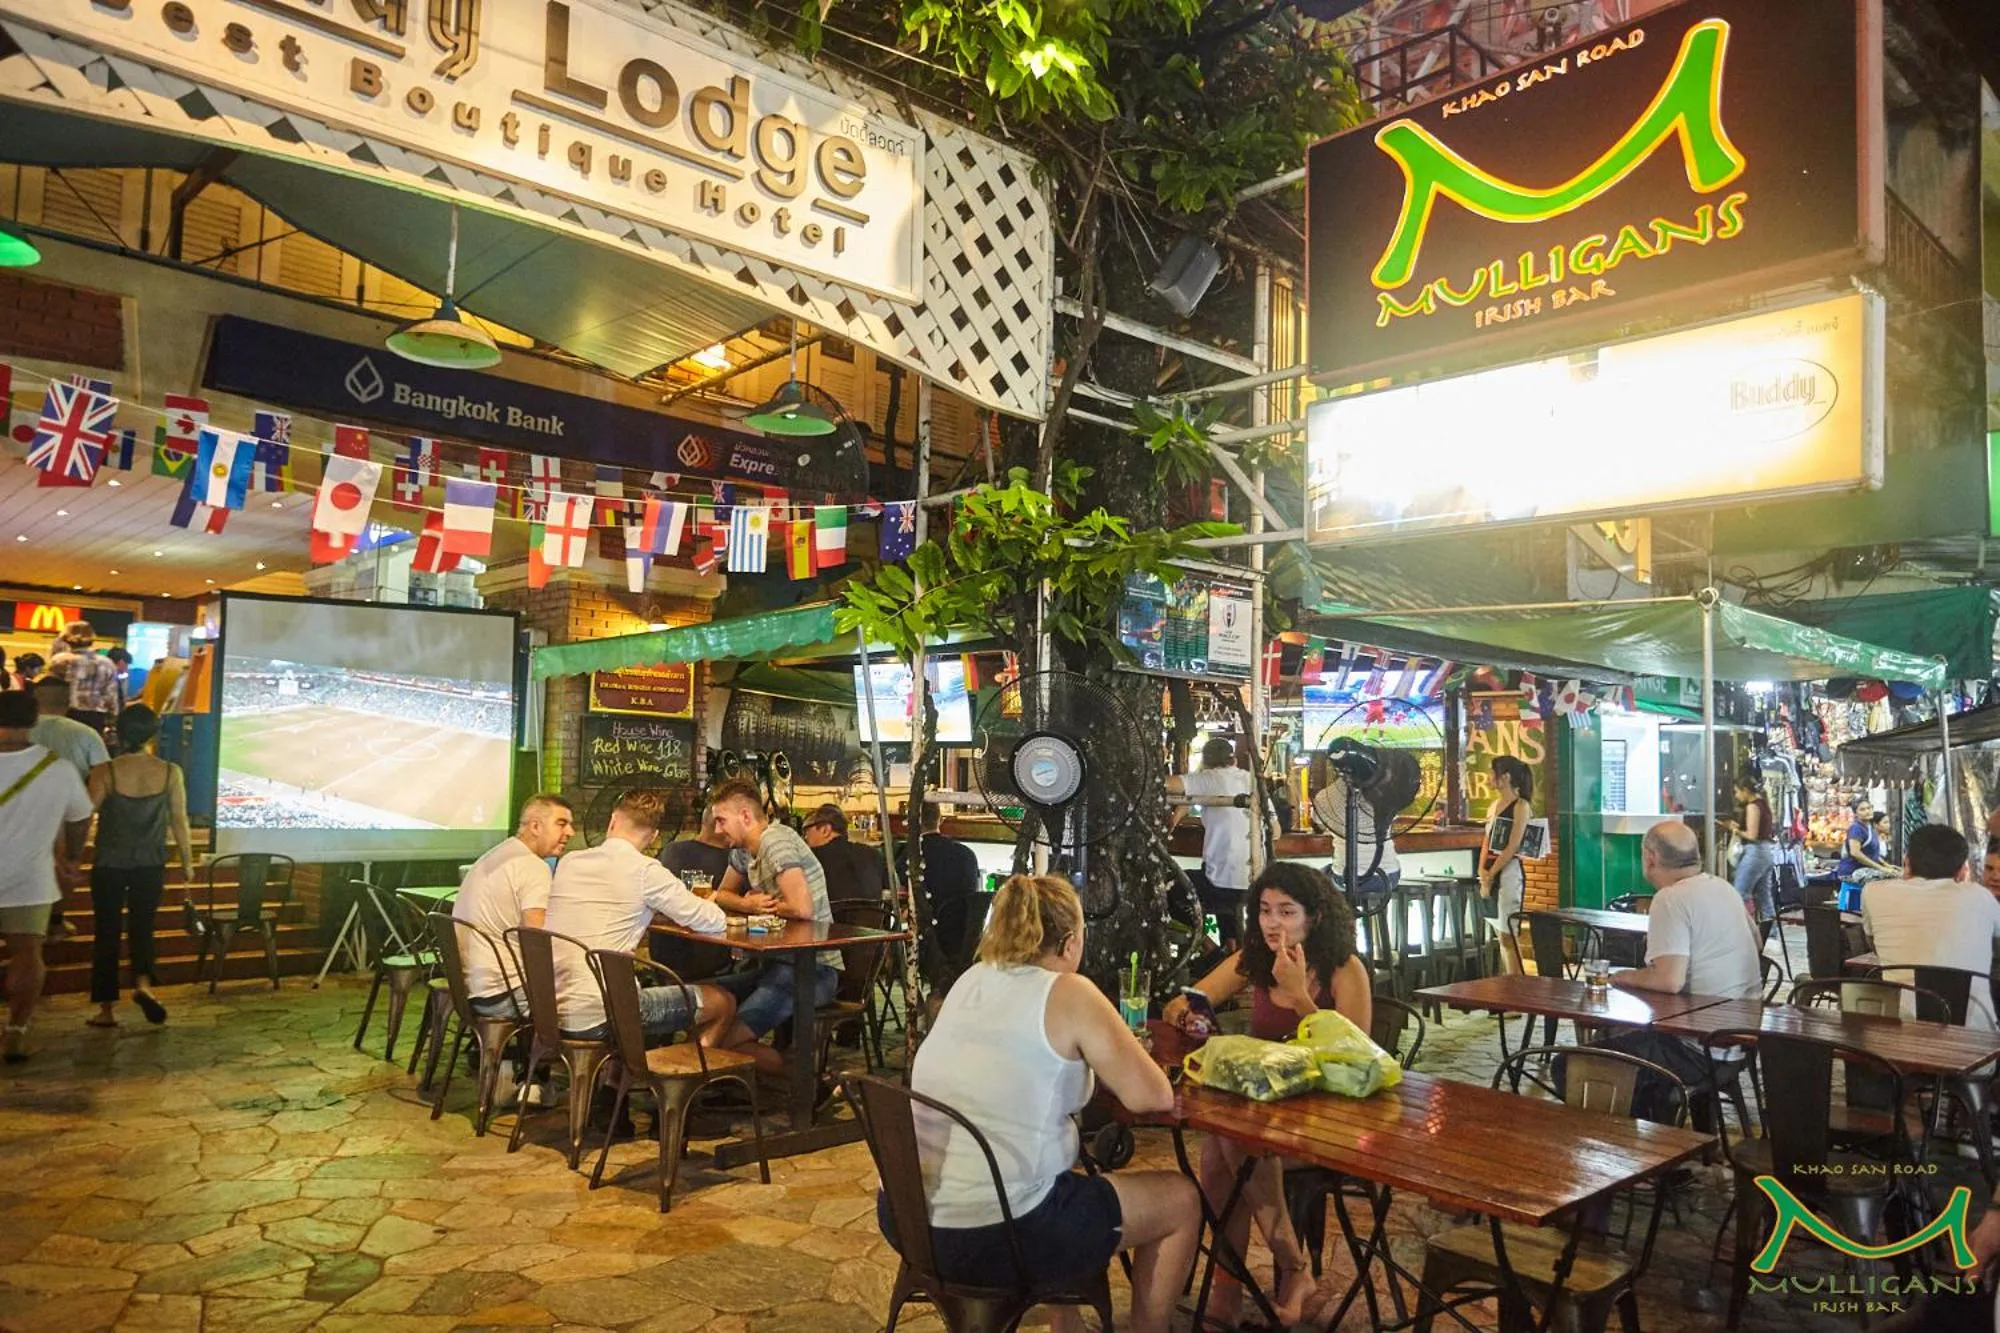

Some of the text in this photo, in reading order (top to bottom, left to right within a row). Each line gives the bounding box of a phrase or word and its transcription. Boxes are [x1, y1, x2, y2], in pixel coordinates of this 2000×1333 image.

[543, 1, 867, 200] Lodge
[1442, 28, 1646, 119] KHAO SAN ROAD
[91, 0, 302, 73] est
[350, 56, 668, 193] Boutique
[701, 180, 846, 256] Hotel
[1376, 191, 1748, 328] MULLIGANS
[1474, 280, 1617, 329] IRISH BAR
[393, 382, 565, 437] Bangkok Bank
[729, 453, 776, 475] Expre
[591, 758, 634, 776] White
[592, 736, 620, 755] Red
